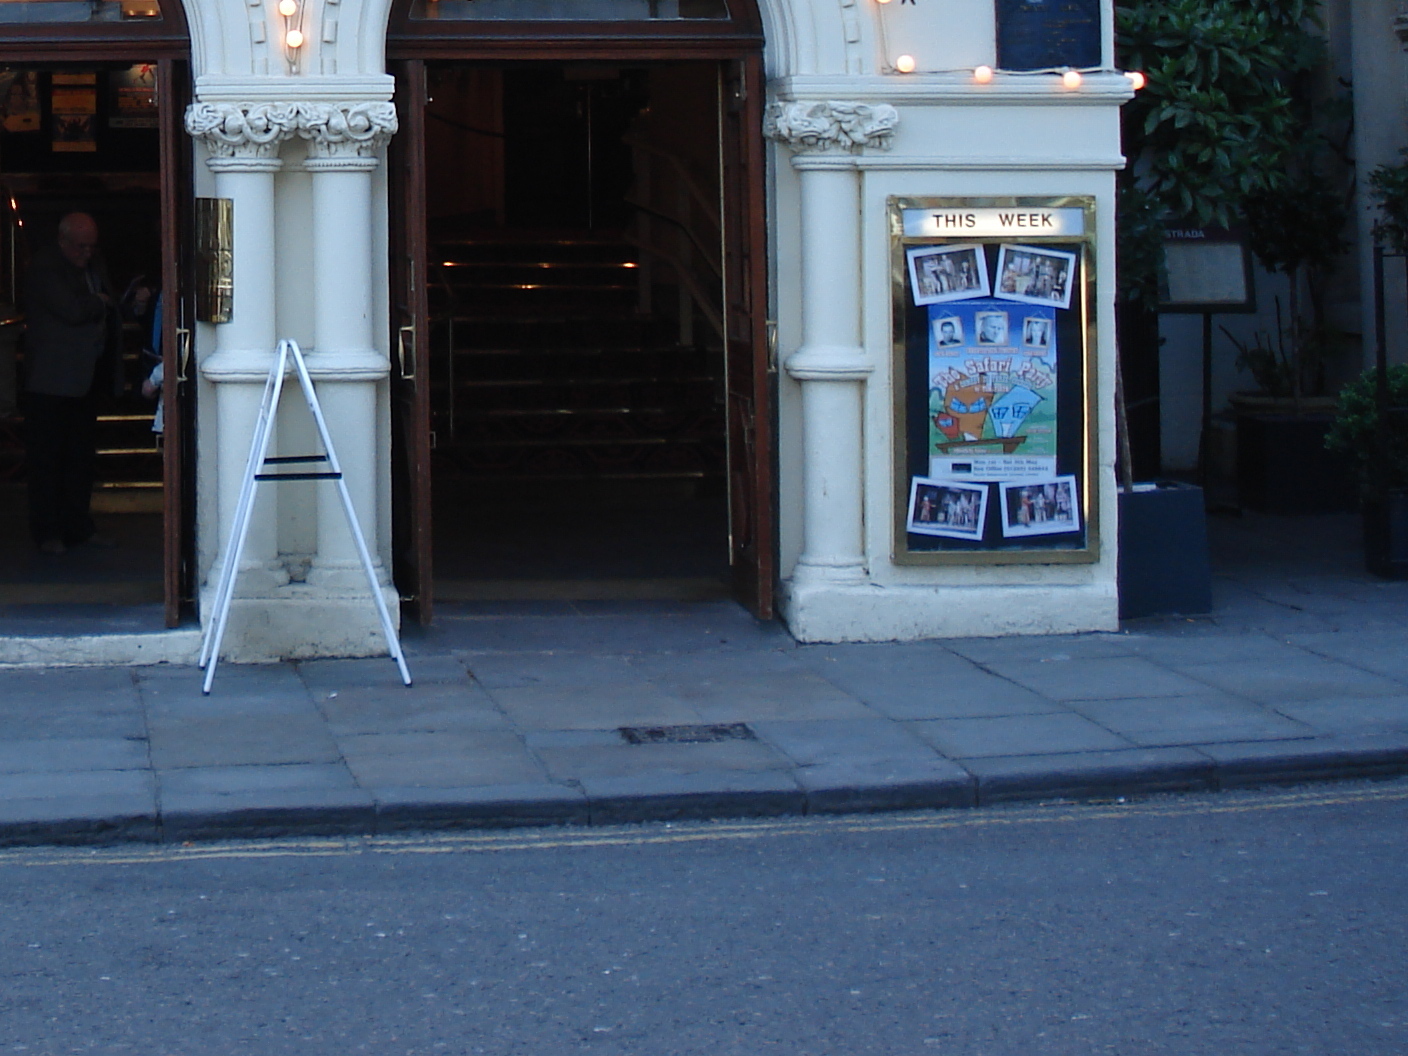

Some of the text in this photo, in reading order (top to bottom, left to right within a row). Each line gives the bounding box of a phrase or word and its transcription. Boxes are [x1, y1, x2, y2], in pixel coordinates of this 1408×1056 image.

[932, 213, 1053, 228] THIS WEEK
[1163, 229, 1205, 239] STRADA
[933, 368, 961, 390] The
[964, 356, 1013, 375] Safari
[1017, 361, 1054, 390] Party
